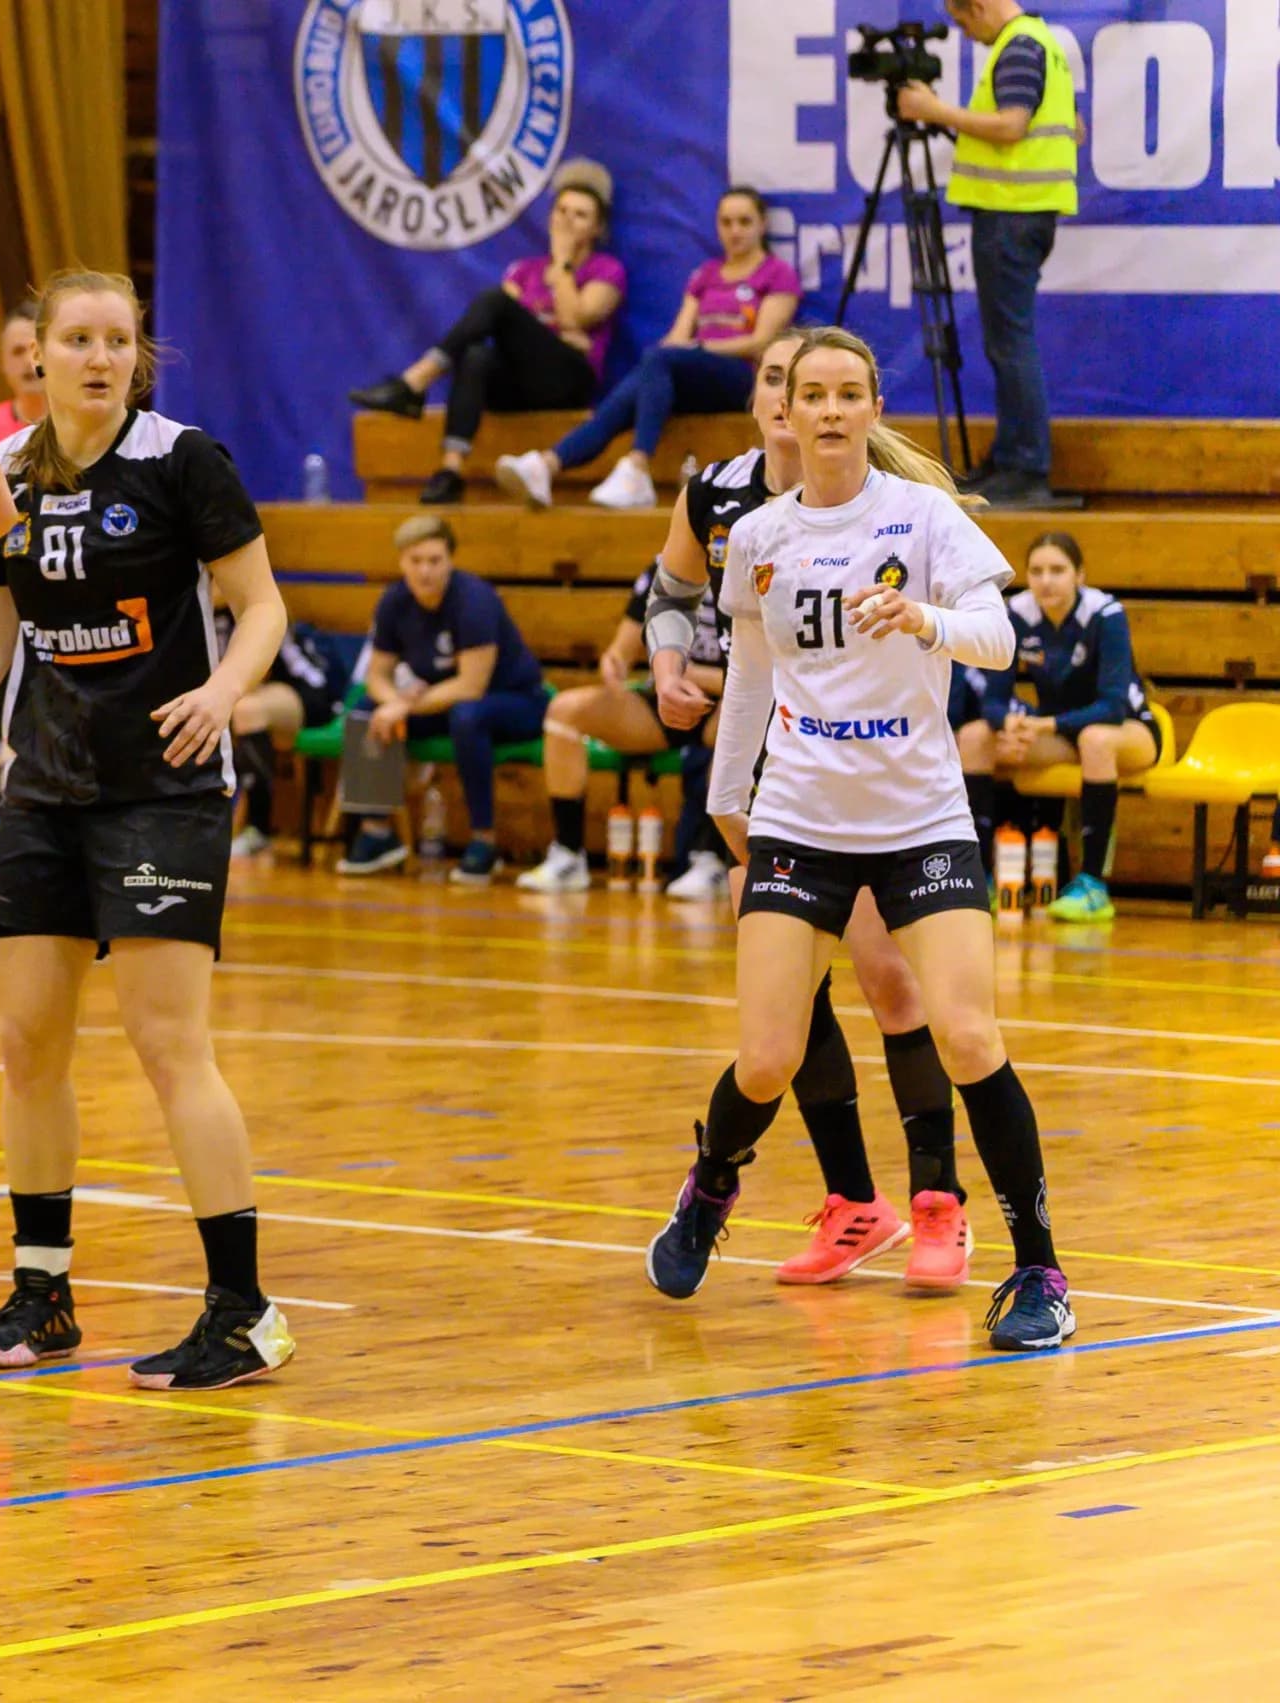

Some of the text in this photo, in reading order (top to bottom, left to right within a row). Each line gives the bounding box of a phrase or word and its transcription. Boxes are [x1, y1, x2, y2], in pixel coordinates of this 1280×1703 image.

[40, 525, 86, 580] 81
[812, 557, 851, 567] PGNiG
[795, 589, 845, 648] 31
[799, 716, 909, 740] SUZUKI
[159, 876, 212, 890] Upstream
[909, 878, 974, 899] PROFIKA
